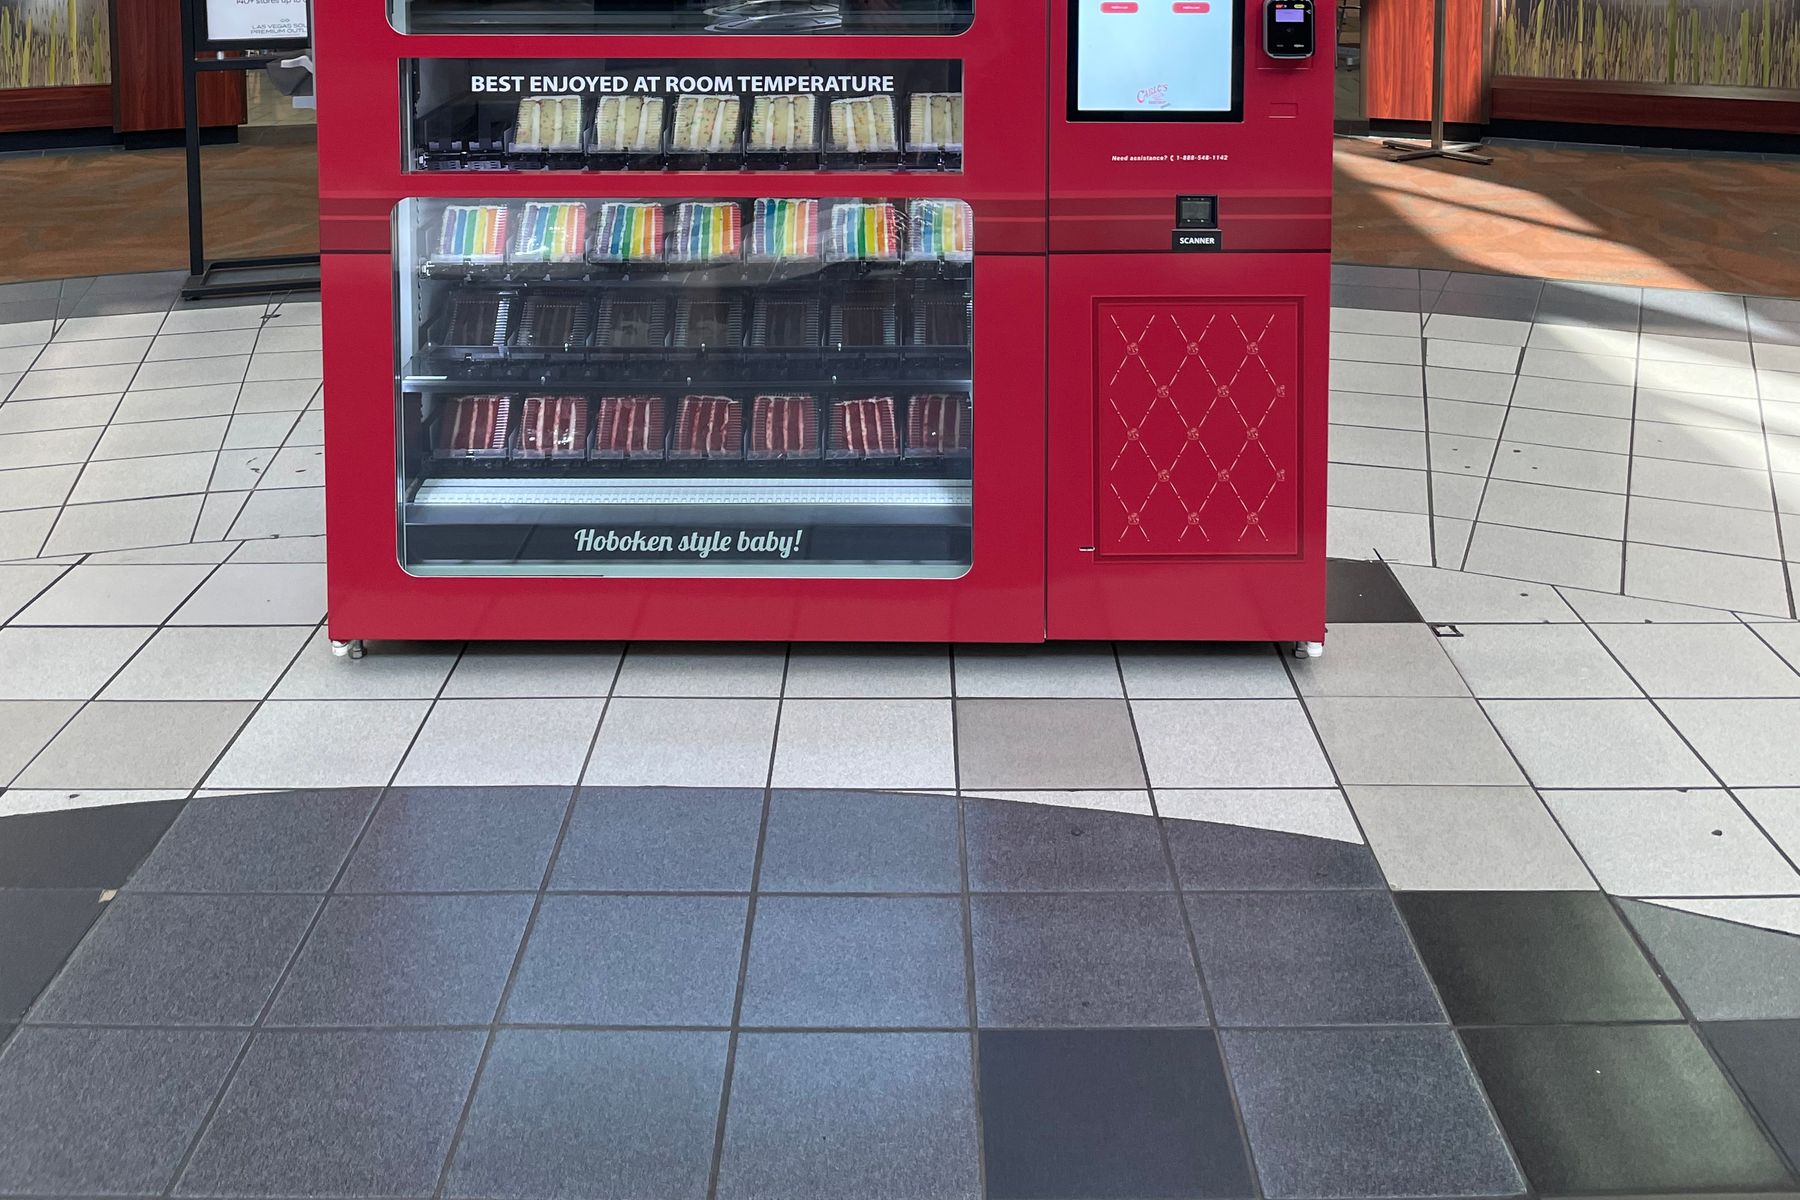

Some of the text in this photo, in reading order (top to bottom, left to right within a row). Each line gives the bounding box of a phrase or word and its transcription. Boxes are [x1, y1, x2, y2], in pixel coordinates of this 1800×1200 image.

[471, 75, 895, 92] BEST ENJOYED AT ROOM TEMPERATURE
[1179, 237, 1215, 245] SCANNER
[574, 528, 803, 559] Hoboken style baby!
